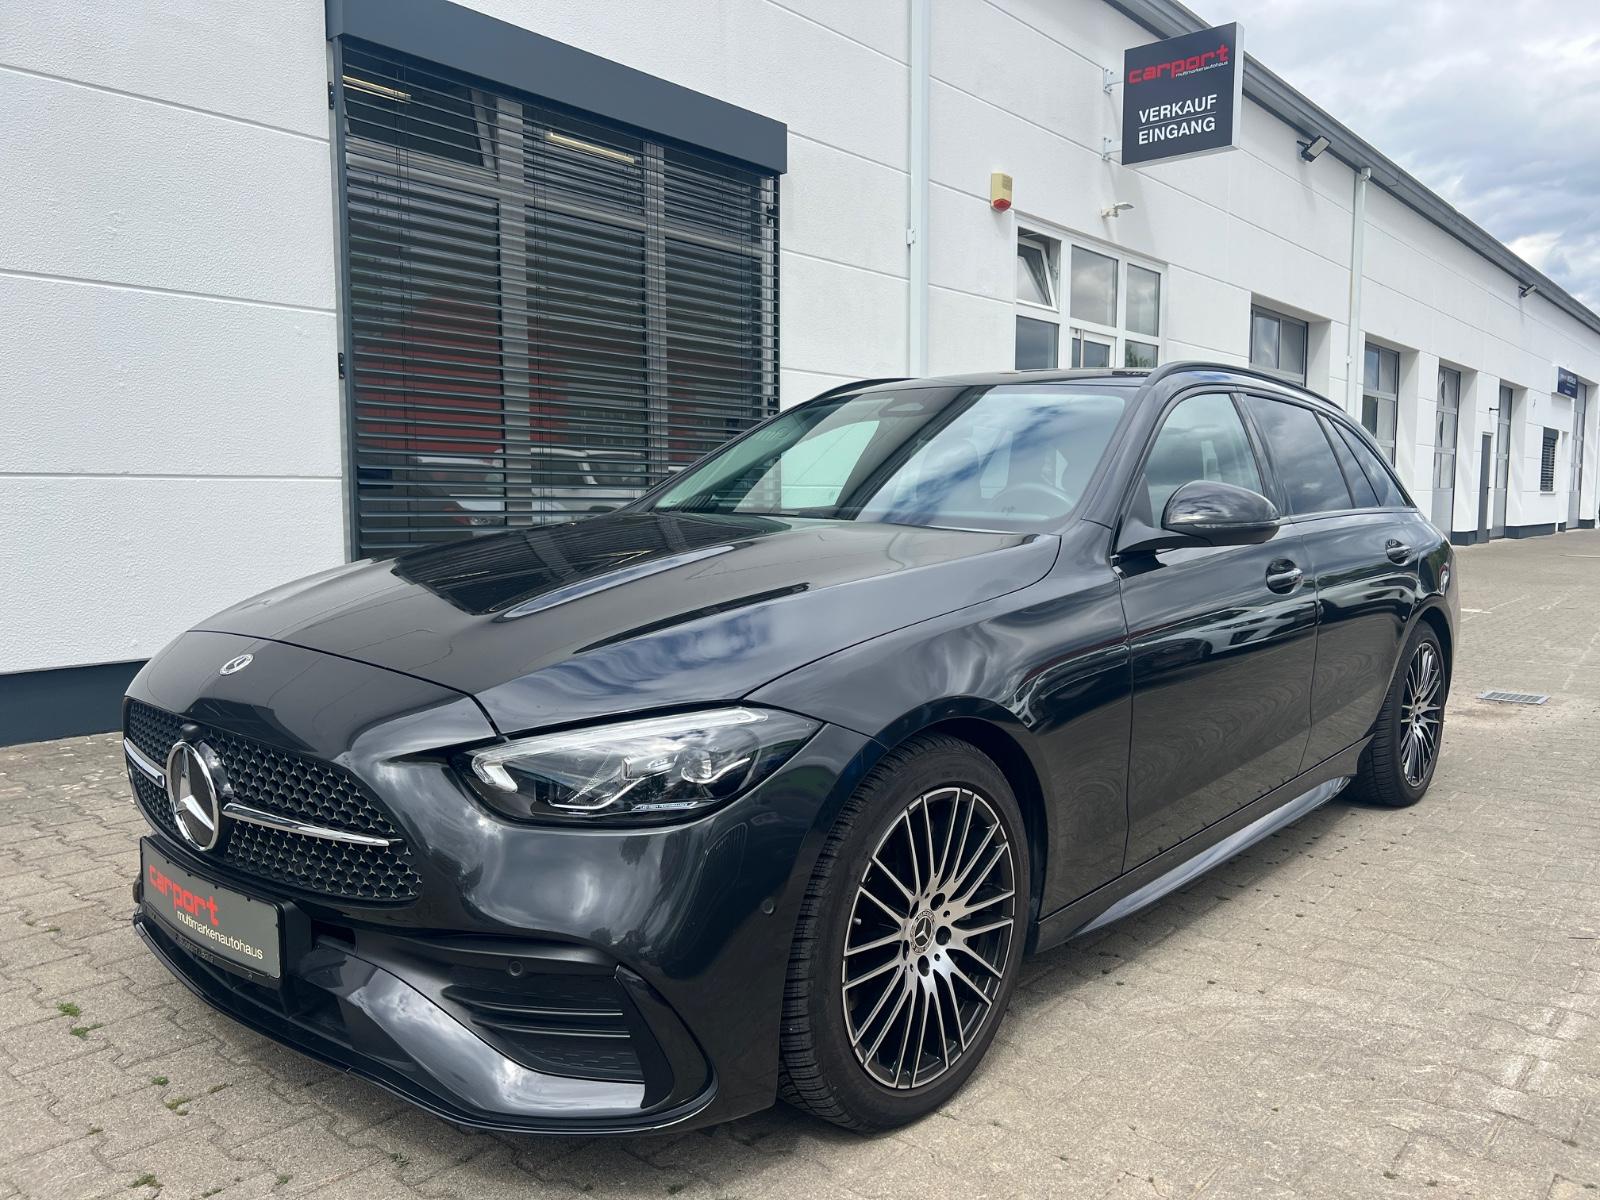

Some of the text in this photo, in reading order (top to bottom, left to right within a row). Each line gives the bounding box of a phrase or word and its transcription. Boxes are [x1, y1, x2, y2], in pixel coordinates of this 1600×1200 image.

[1128, 43, 1229, 84] carport
[1138, 94, 1218, 123] VERKAUF
[1138, 117, 1216, 145] EINGANG
[149, 864, 219, 926] carport
[177, 911, 263, 959] multimarkenautohaus
